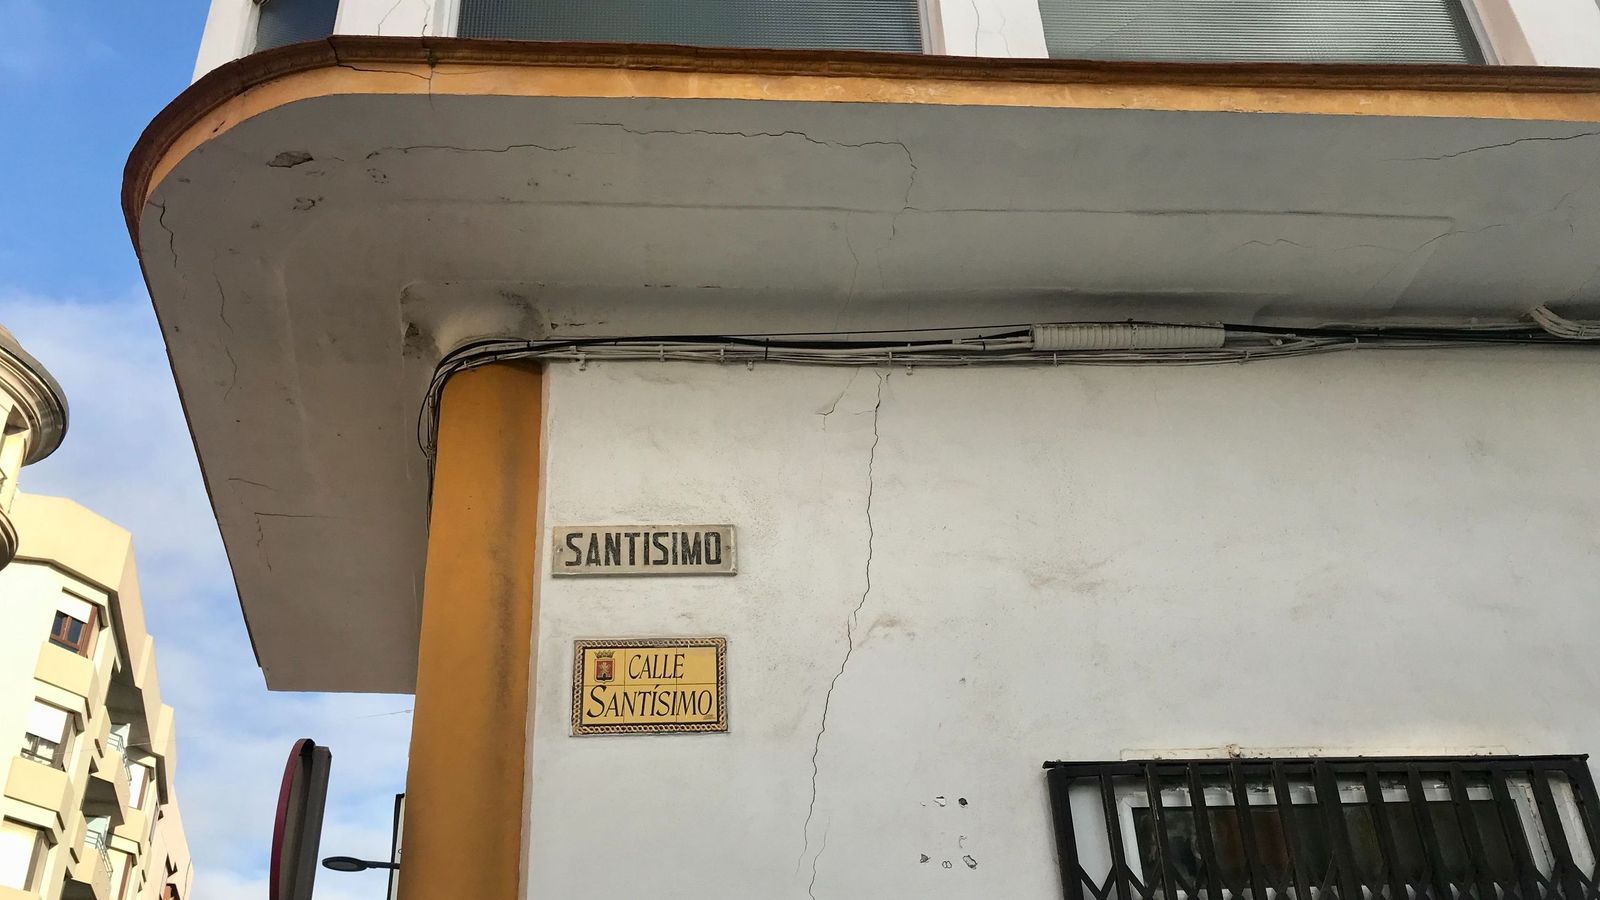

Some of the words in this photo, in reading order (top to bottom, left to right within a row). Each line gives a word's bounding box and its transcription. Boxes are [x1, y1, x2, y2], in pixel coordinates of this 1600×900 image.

[565, 531, 722, 567] SANTISIMO
[628, 653, 685, 680] CALLE
[586, 684, 713, 718] SANTÍSIMO
